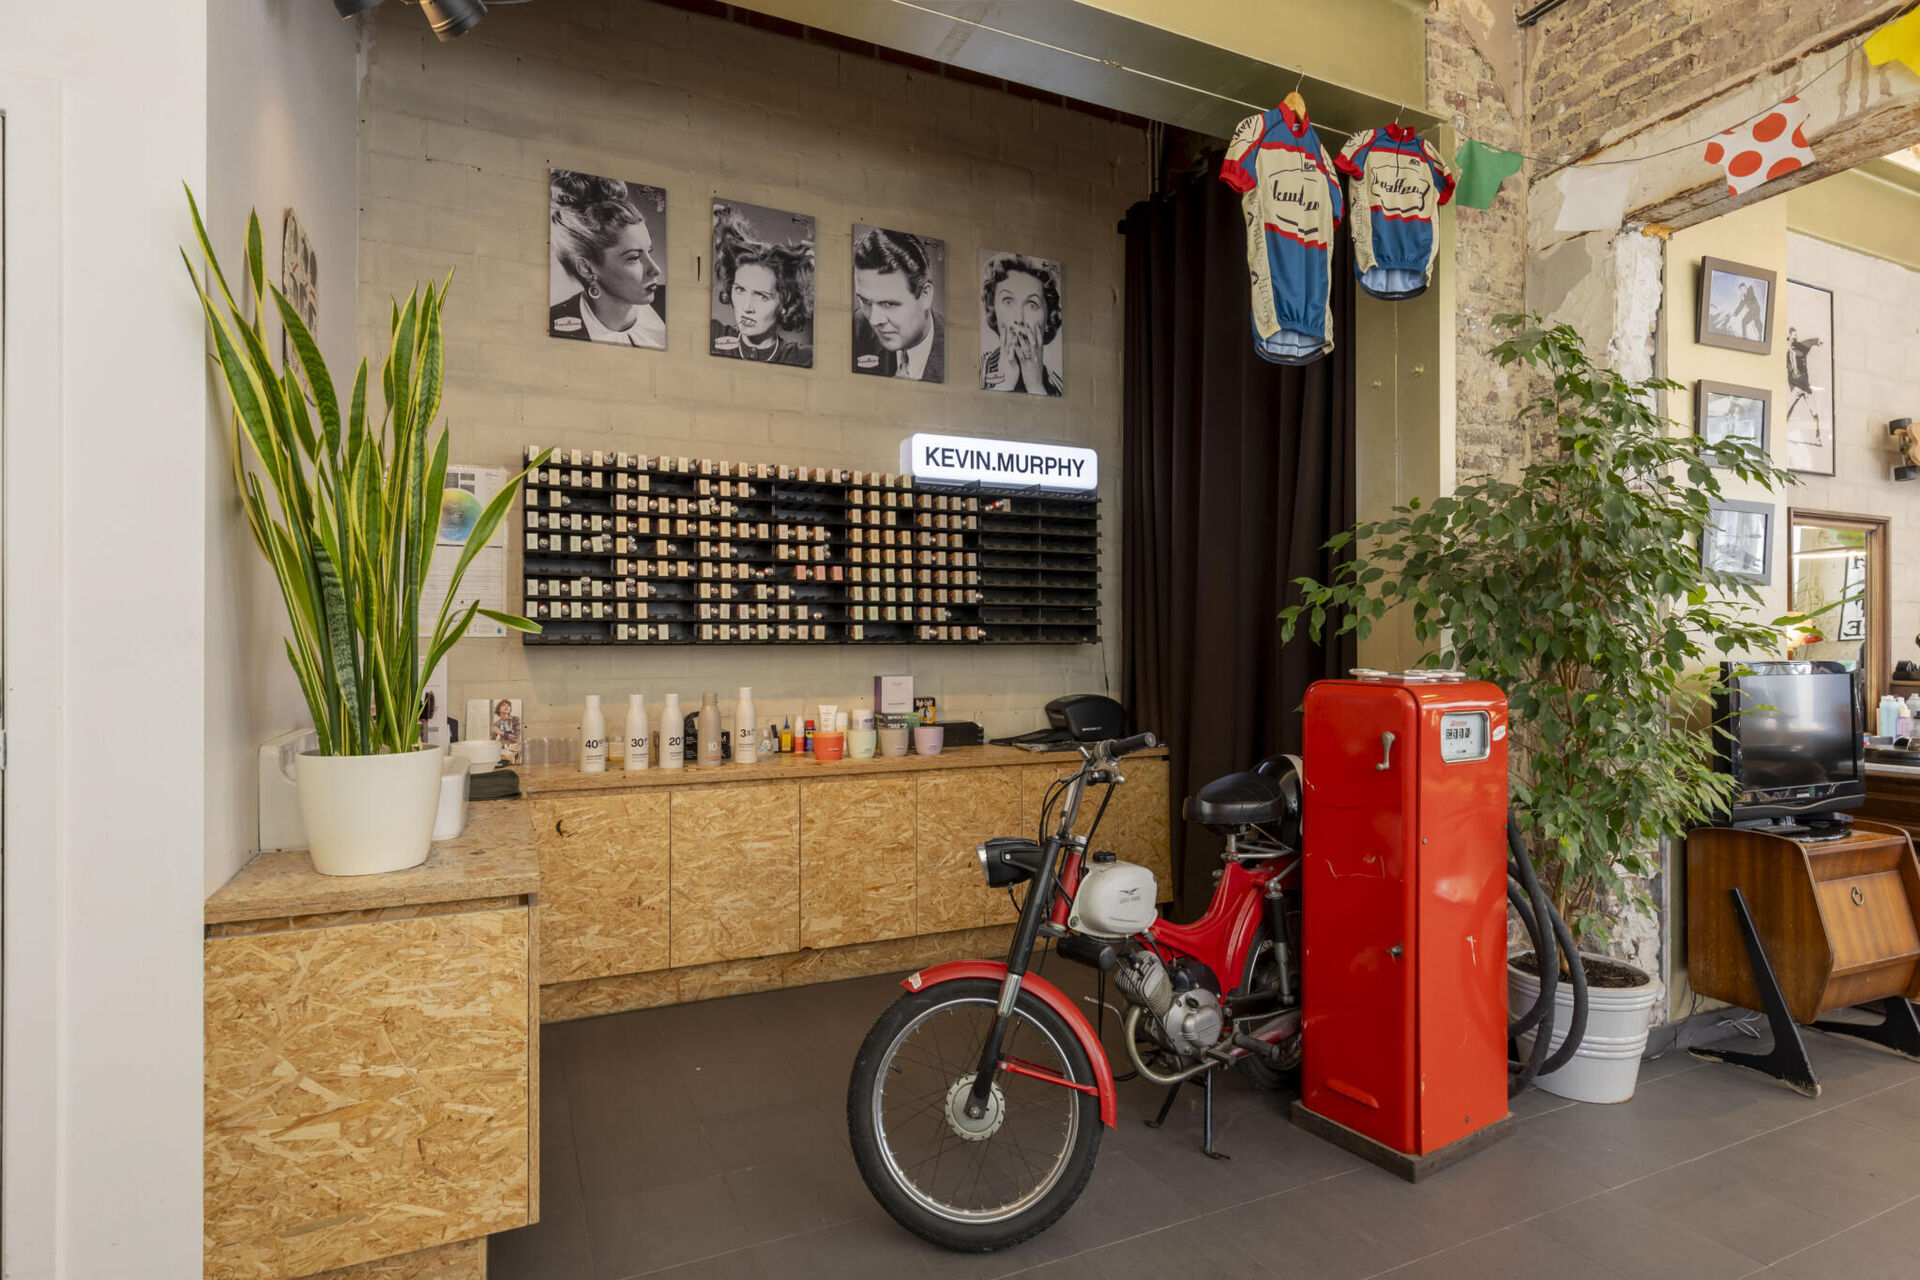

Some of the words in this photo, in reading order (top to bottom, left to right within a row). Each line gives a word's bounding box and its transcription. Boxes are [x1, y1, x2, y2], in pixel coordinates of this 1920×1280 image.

[925, 446, 1085, 477] KEVIN.MURPHY
[584, 739, 599, 749] 40
[631, 738, 644, 748] 30
[668, 736, 681, 746] 20
